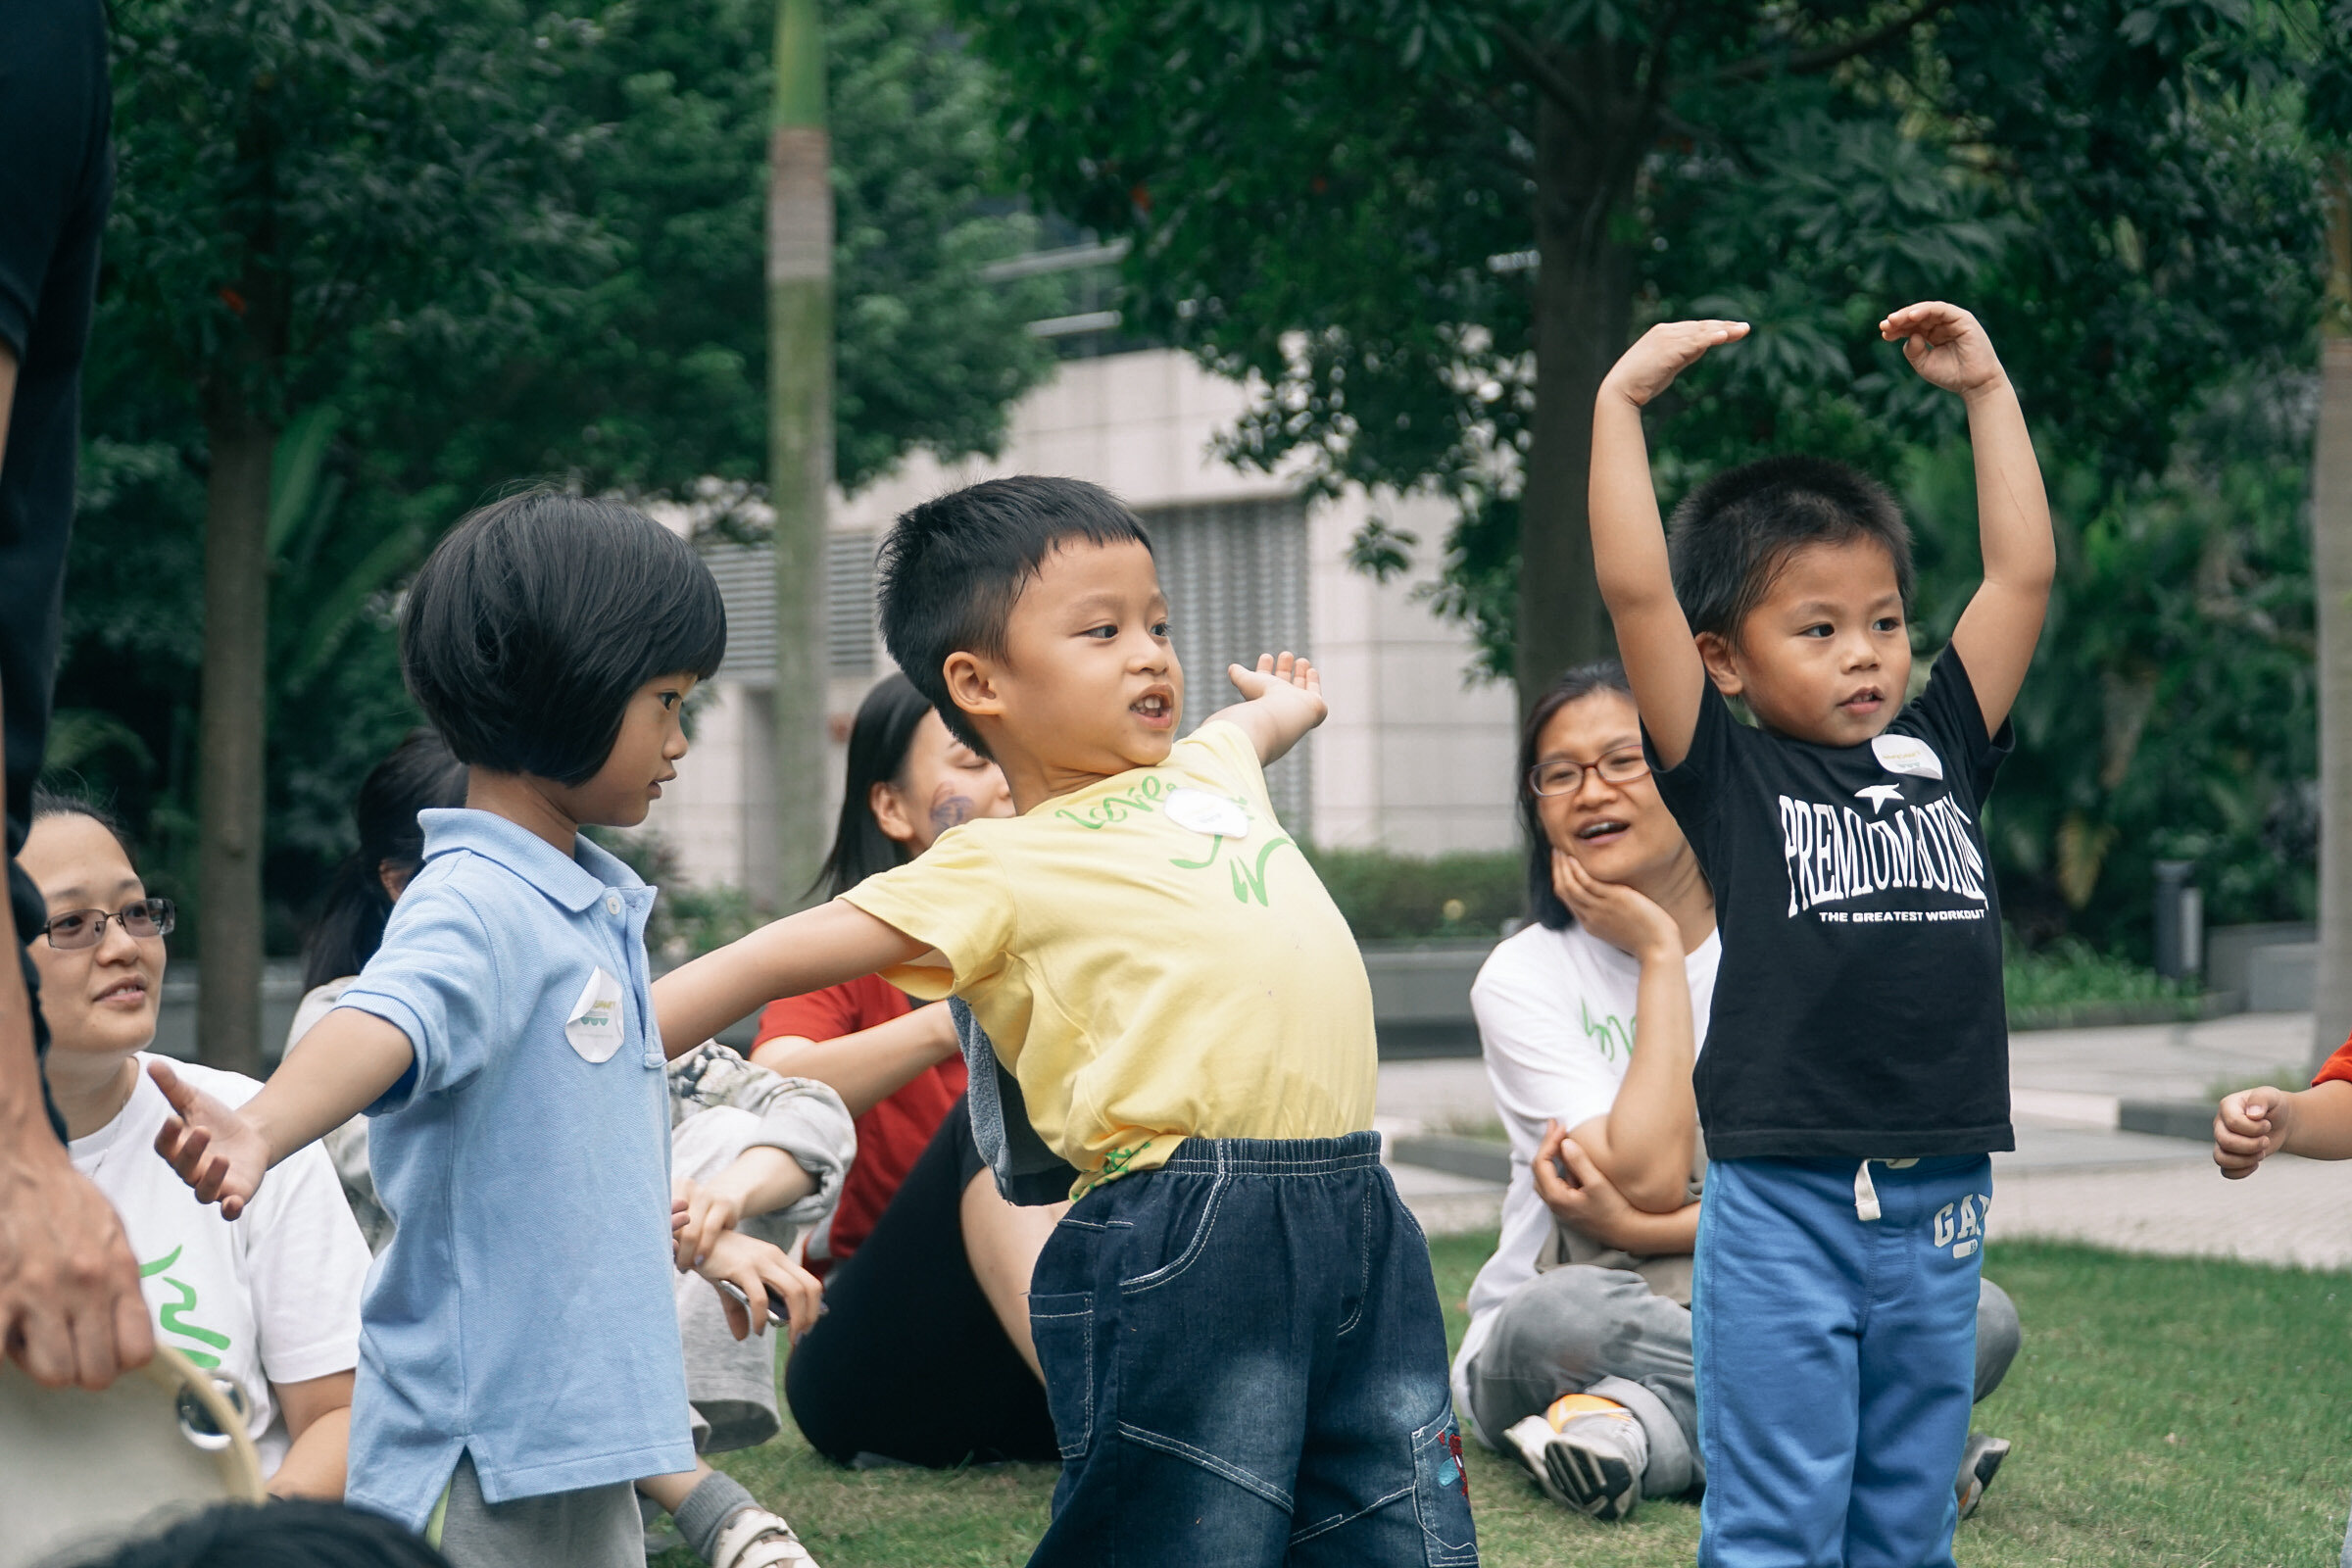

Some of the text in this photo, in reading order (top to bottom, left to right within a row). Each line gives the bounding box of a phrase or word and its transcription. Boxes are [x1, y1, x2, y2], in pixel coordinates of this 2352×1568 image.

[1779, 794, 1918, 918] PREMIUM
[1819, 908, 1985, 922] THE GREATEST WORKOUT
